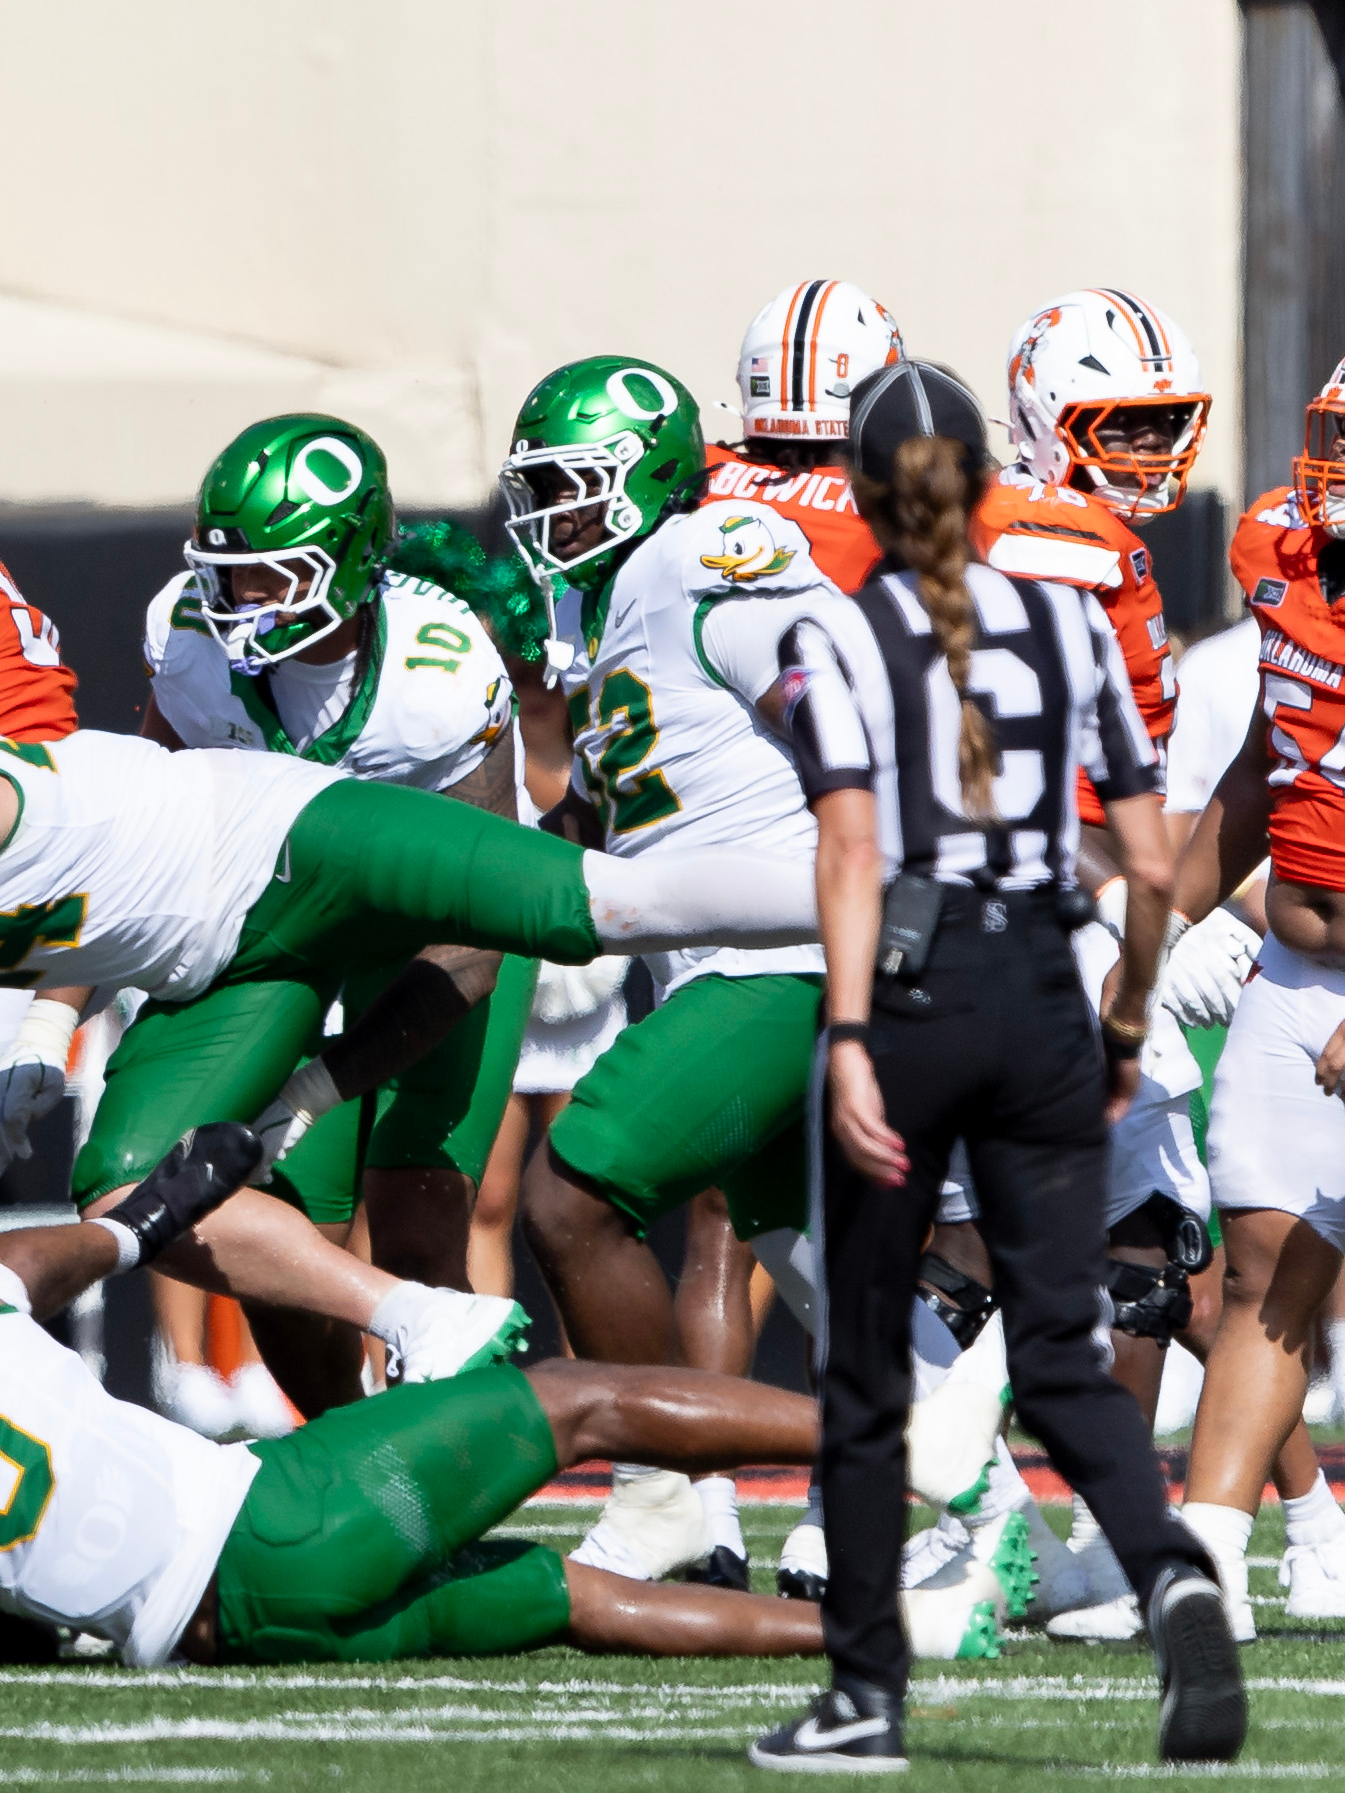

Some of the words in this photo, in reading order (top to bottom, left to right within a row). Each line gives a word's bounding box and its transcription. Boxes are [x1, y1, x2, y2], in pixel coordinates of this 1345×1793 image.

[606, 367, 678, 421] O
[754, 418, 809, 435] OKLAHOMA
[815, 419, 849, 437] STATE
[294, 436, 363, 506] O
[404, 622, 473, 676] 10
[925, 648, 1046, 820] C
